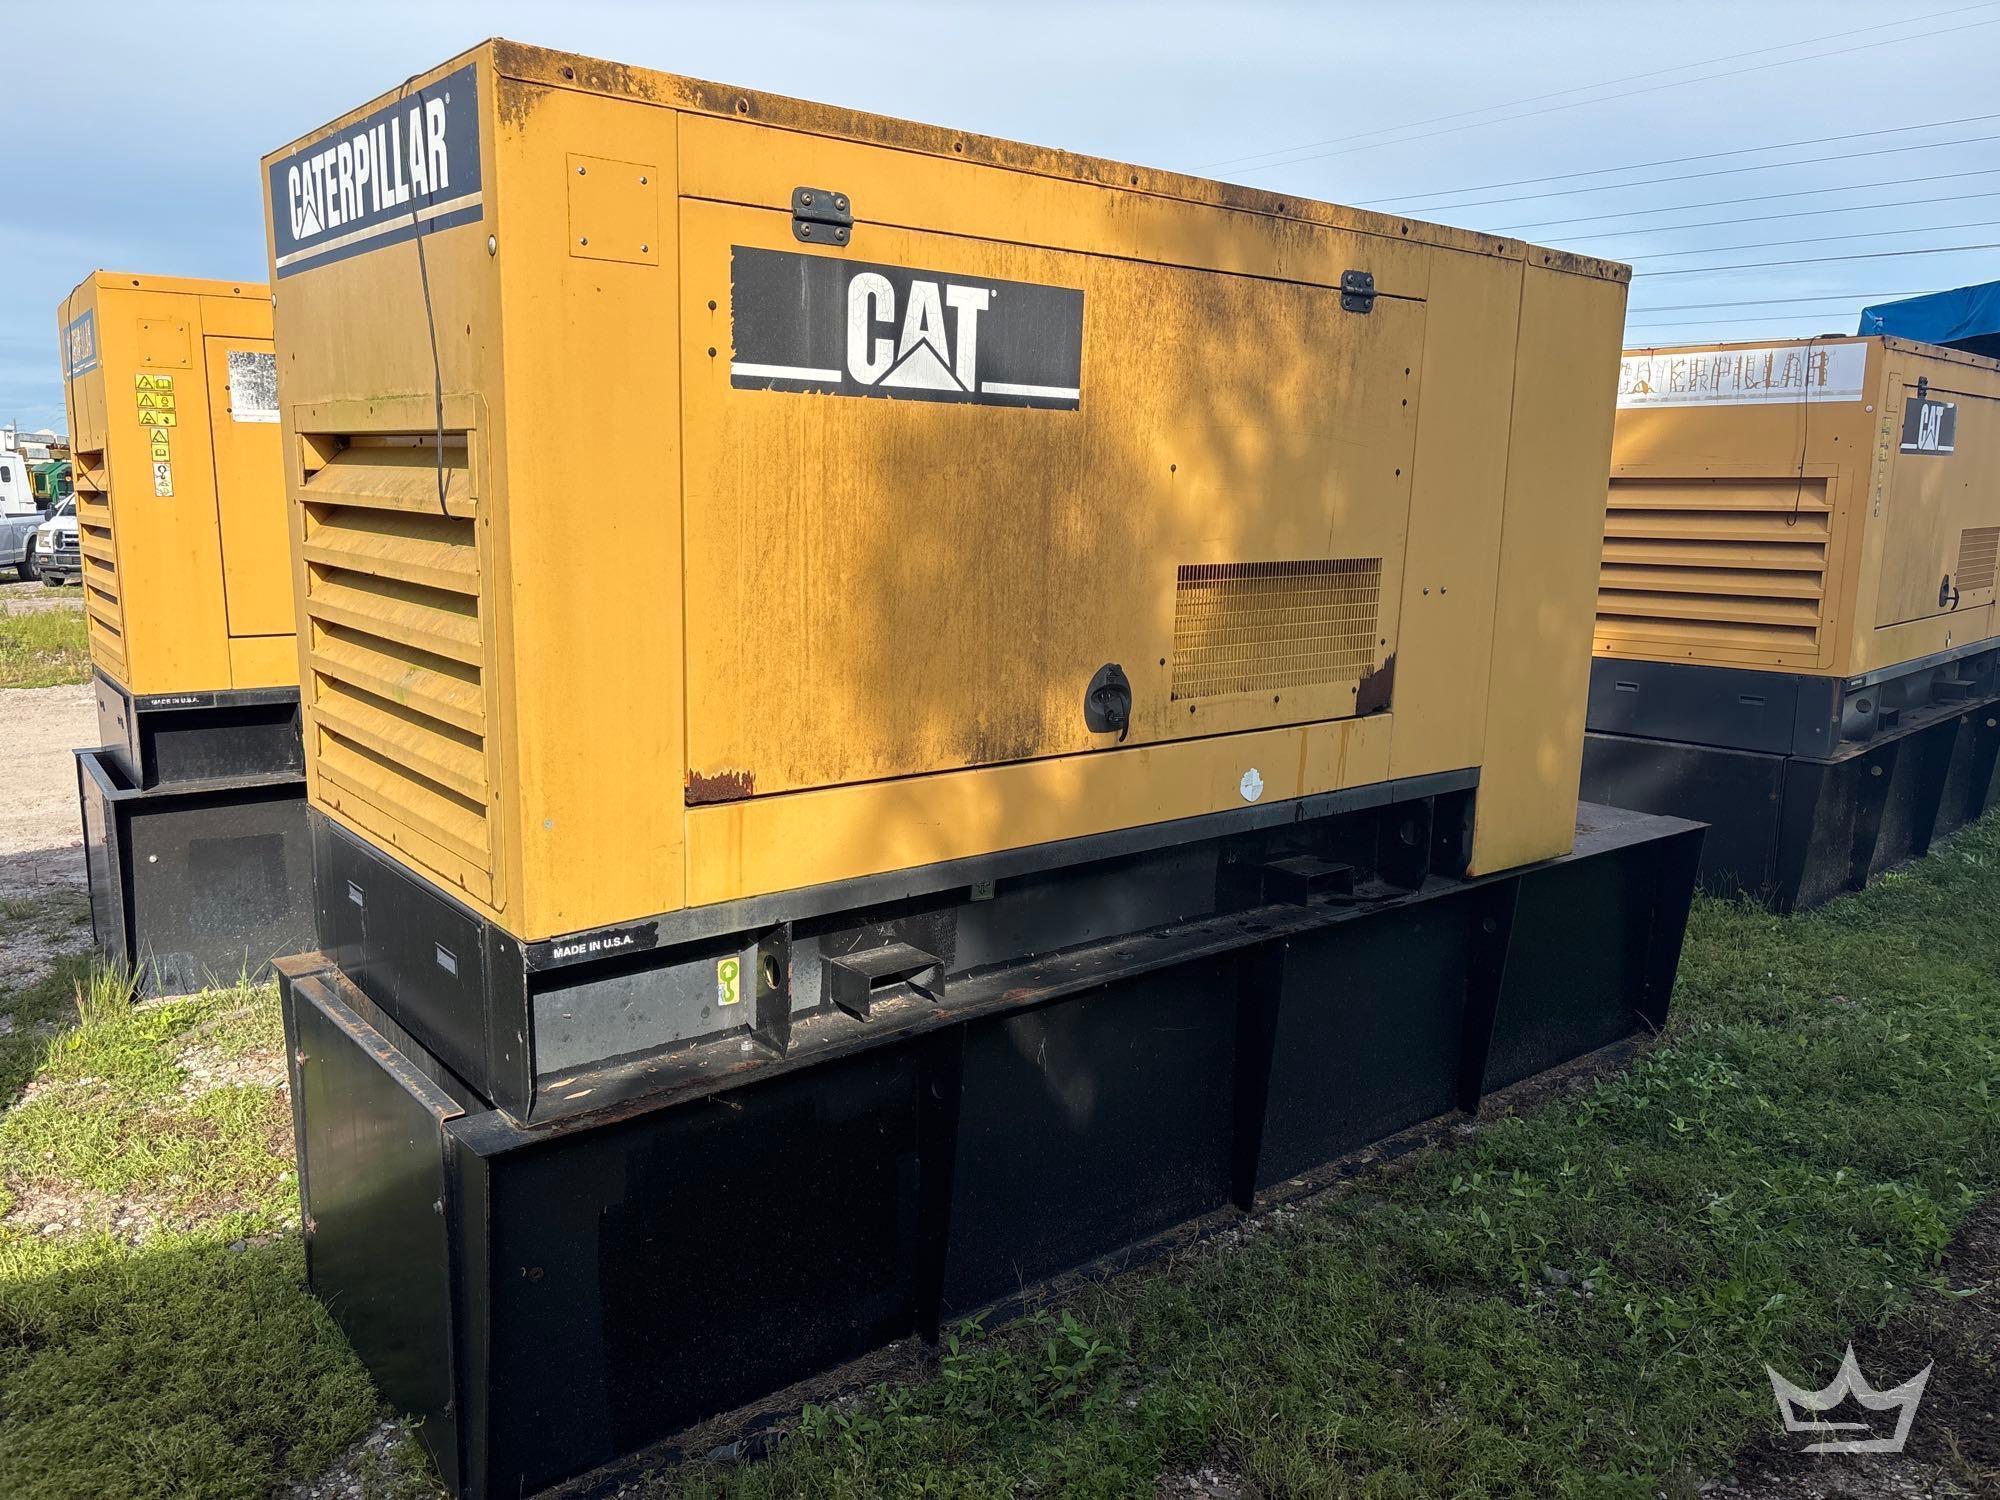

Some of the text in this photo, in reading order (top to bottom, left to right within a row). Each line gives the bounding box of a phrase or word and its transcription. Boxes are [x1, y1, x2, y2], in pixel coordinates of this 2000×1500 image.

[288, 97, 449, 240] CATERPILLAR
[847, 272, 989, 393] CAT
[1918, 404, 1944, 450] CAT
[553, 935, 634, 958] MADE IN U.S.A.
